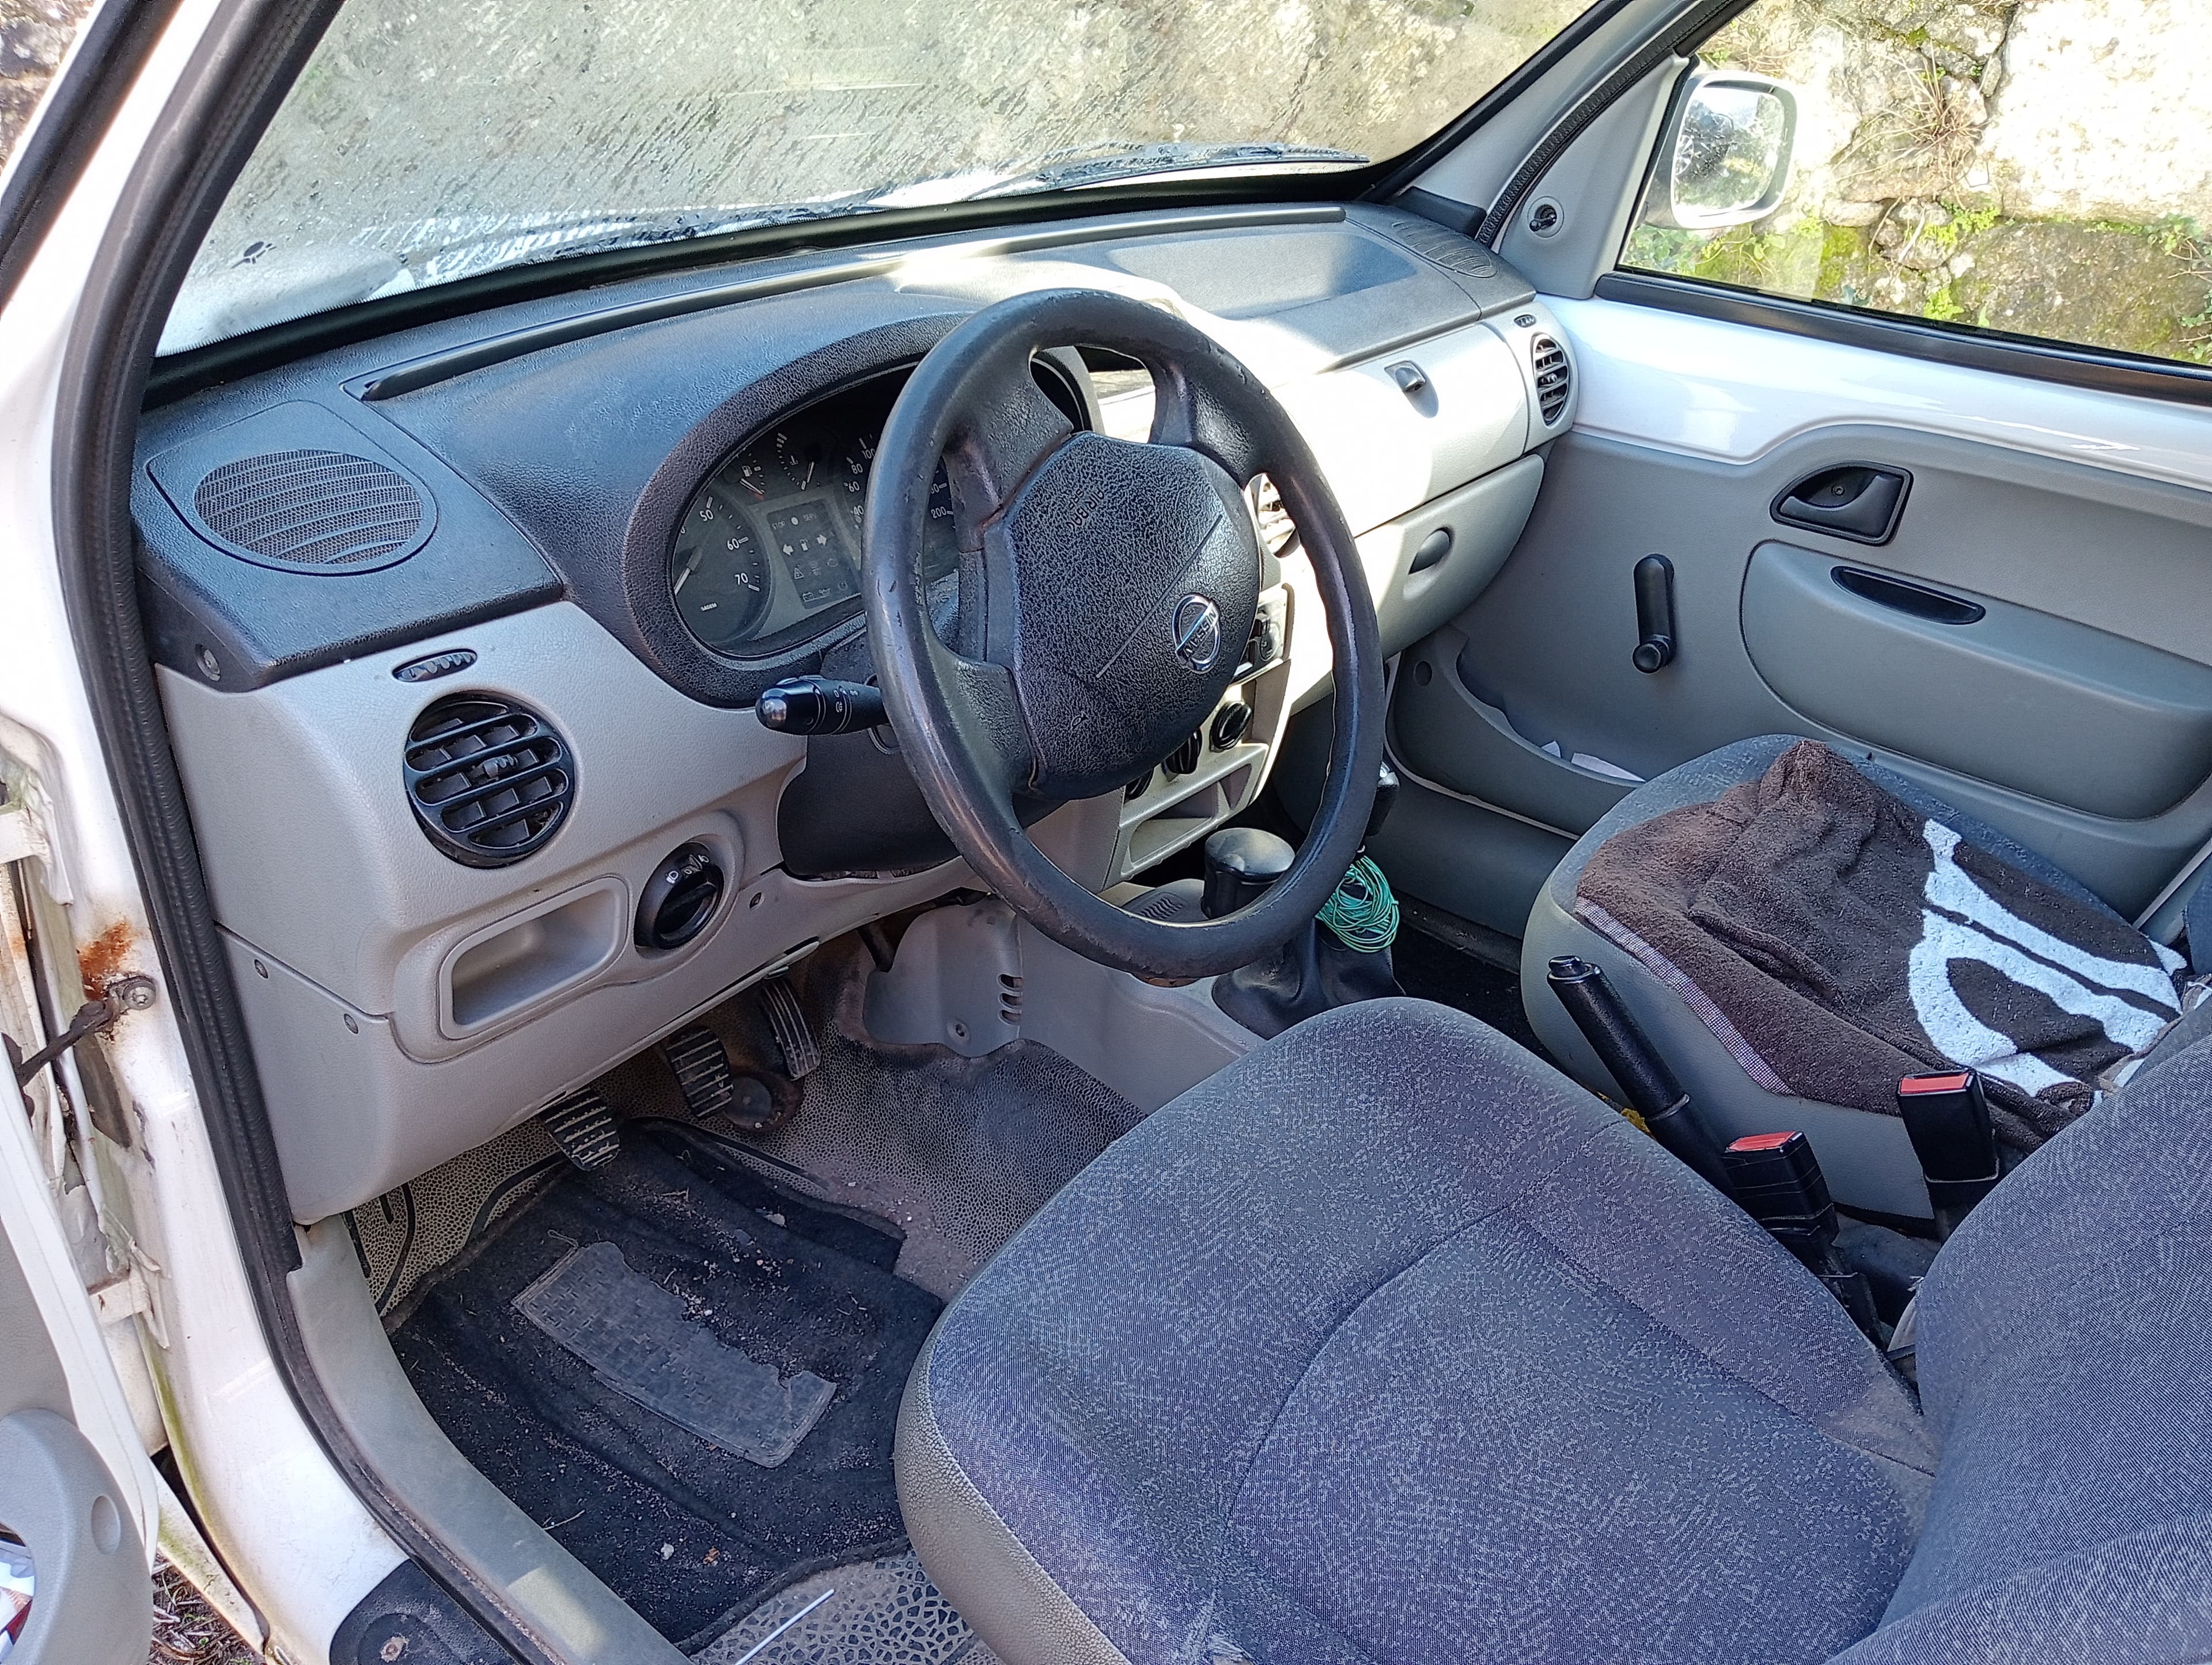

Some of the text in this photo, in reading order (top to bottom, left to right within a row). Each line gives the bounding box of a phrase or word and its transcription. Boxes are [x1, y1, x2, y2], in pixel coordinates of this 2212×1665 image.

[862, 449, 876, 459] 100
[851, 464, 863, 474] 80
[849, 481, 860, 492] 60
[700, 509, 714, 522] 50
[854, 505, 864, 515] 40
[931, 506, 946, 519] 200
[1066, 486, 1104, 532] AIR BAG
[727, 538, 740, 551] 60
[734, 572, 748, 585] 70
[1183, 610, 1217, 658] NISSAN
